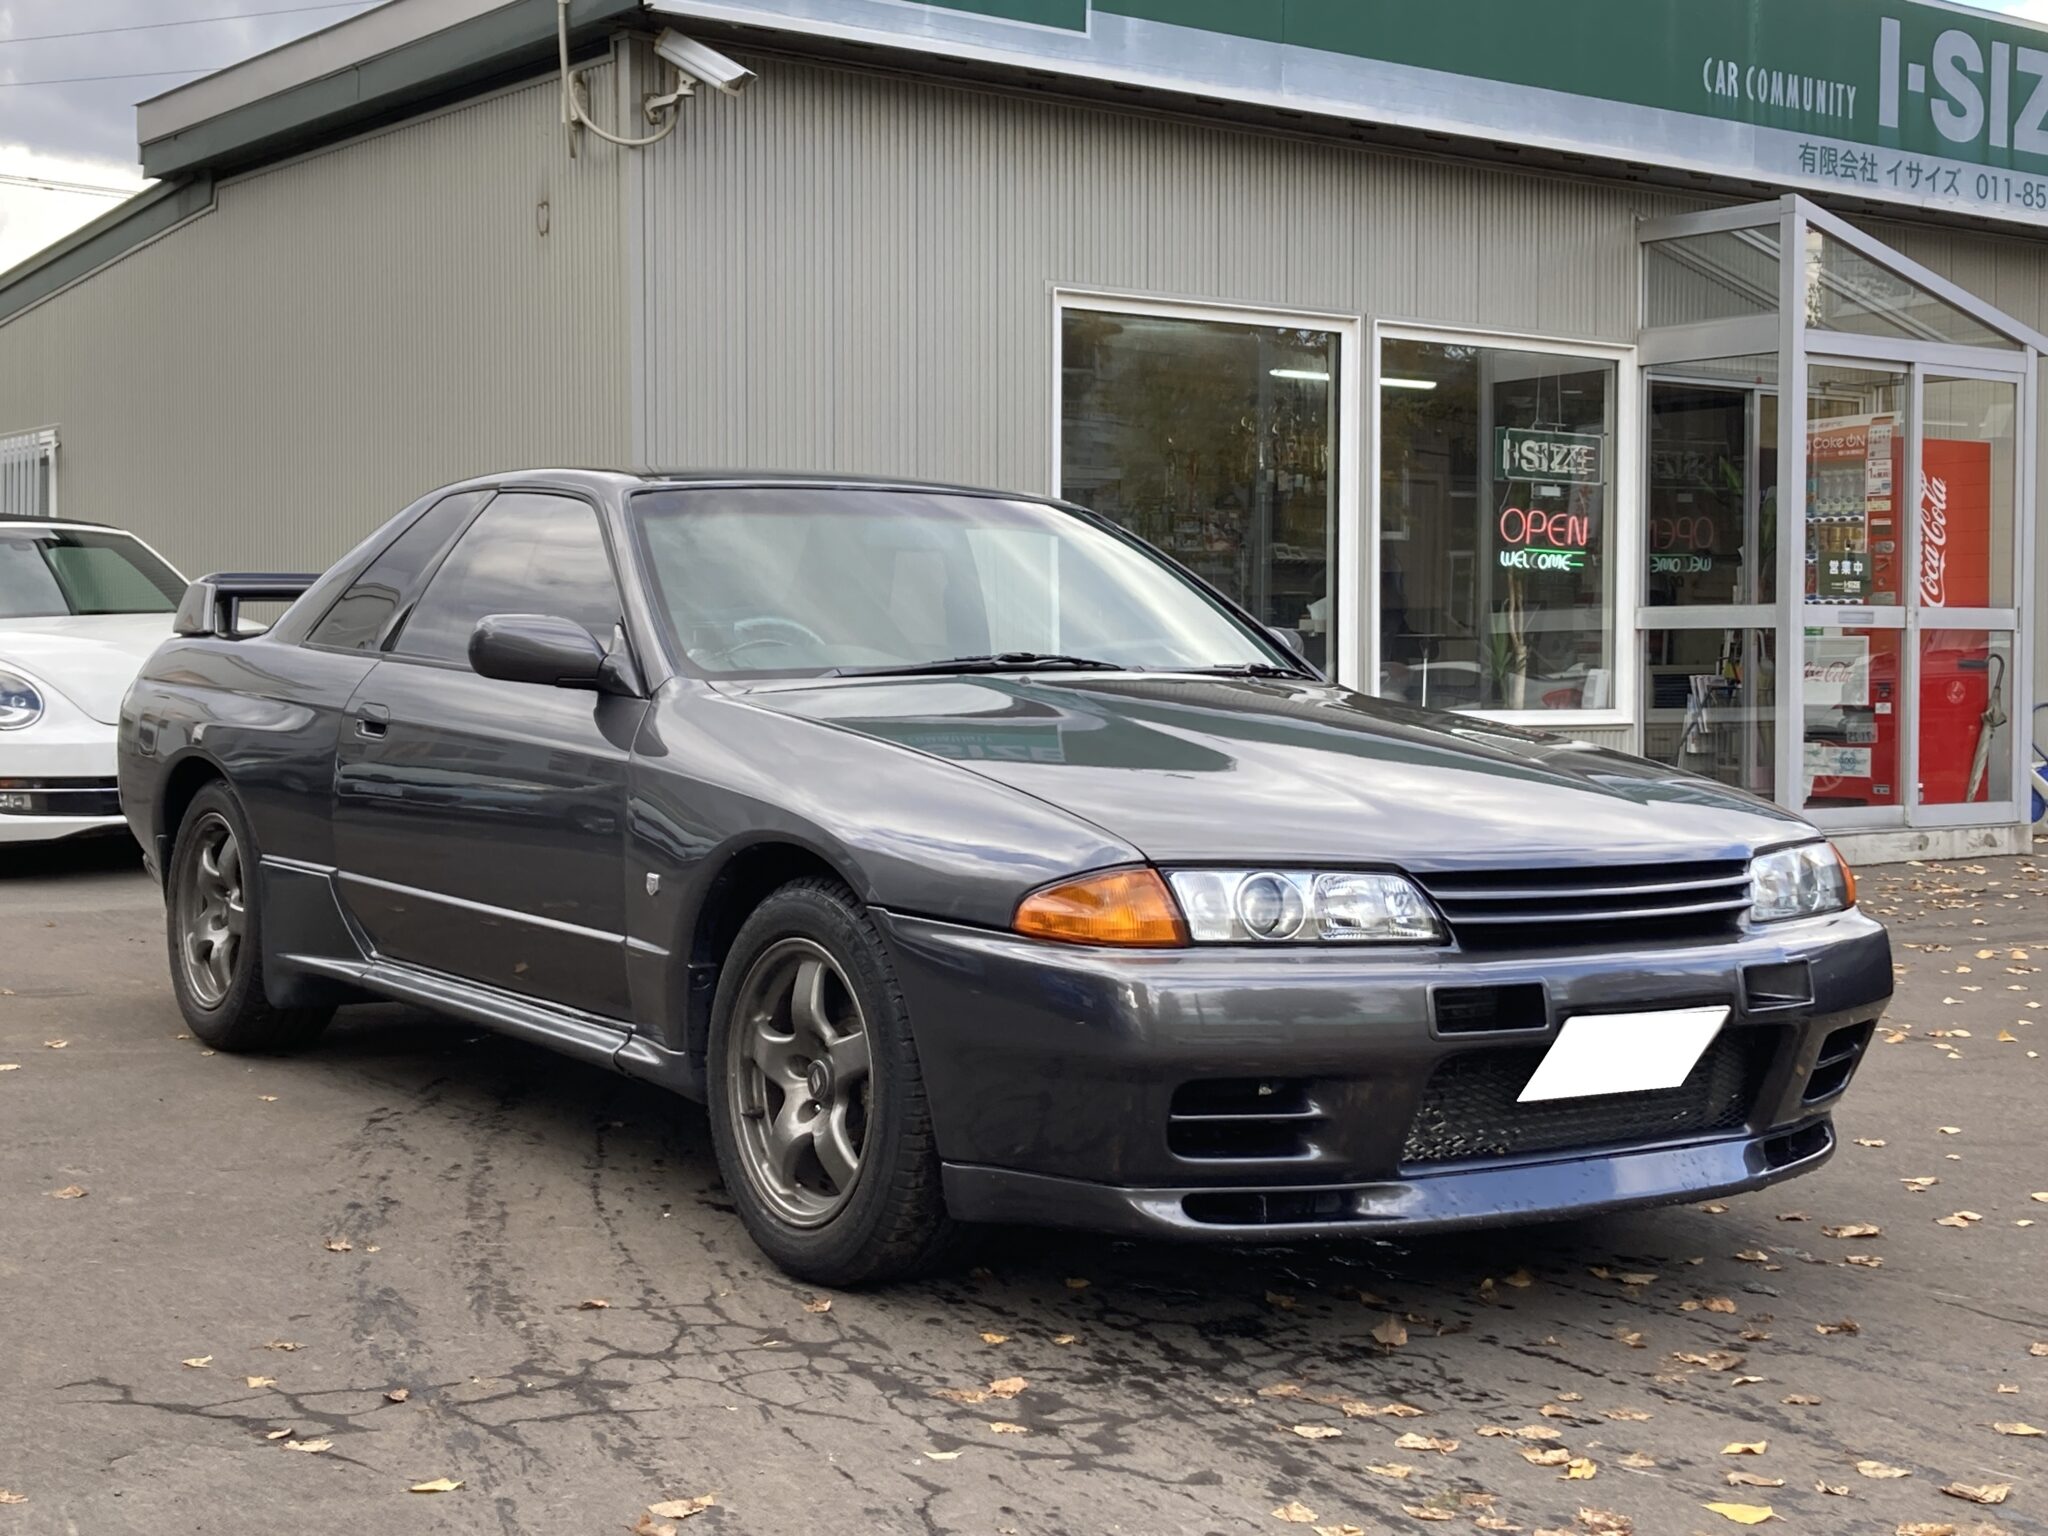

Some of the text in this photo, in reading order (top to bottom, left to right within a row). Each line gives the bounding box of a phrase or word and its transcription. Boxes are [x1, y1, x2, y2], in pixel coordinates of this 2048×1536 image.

[1702, 57, 1857, 120] CAR COMMUNITY
[1798, 142, 2047, 209] 有限会社 イサイズ 011-85
[1813, 436, 1845, 450] Coke
[1846, 432, 1866, 448] ON
[1500, 508, 1588, 546] OPEN
[1920, 470, 1947, 607] Coca-Cola
[1829, 560, 1863, 575] 営業中
